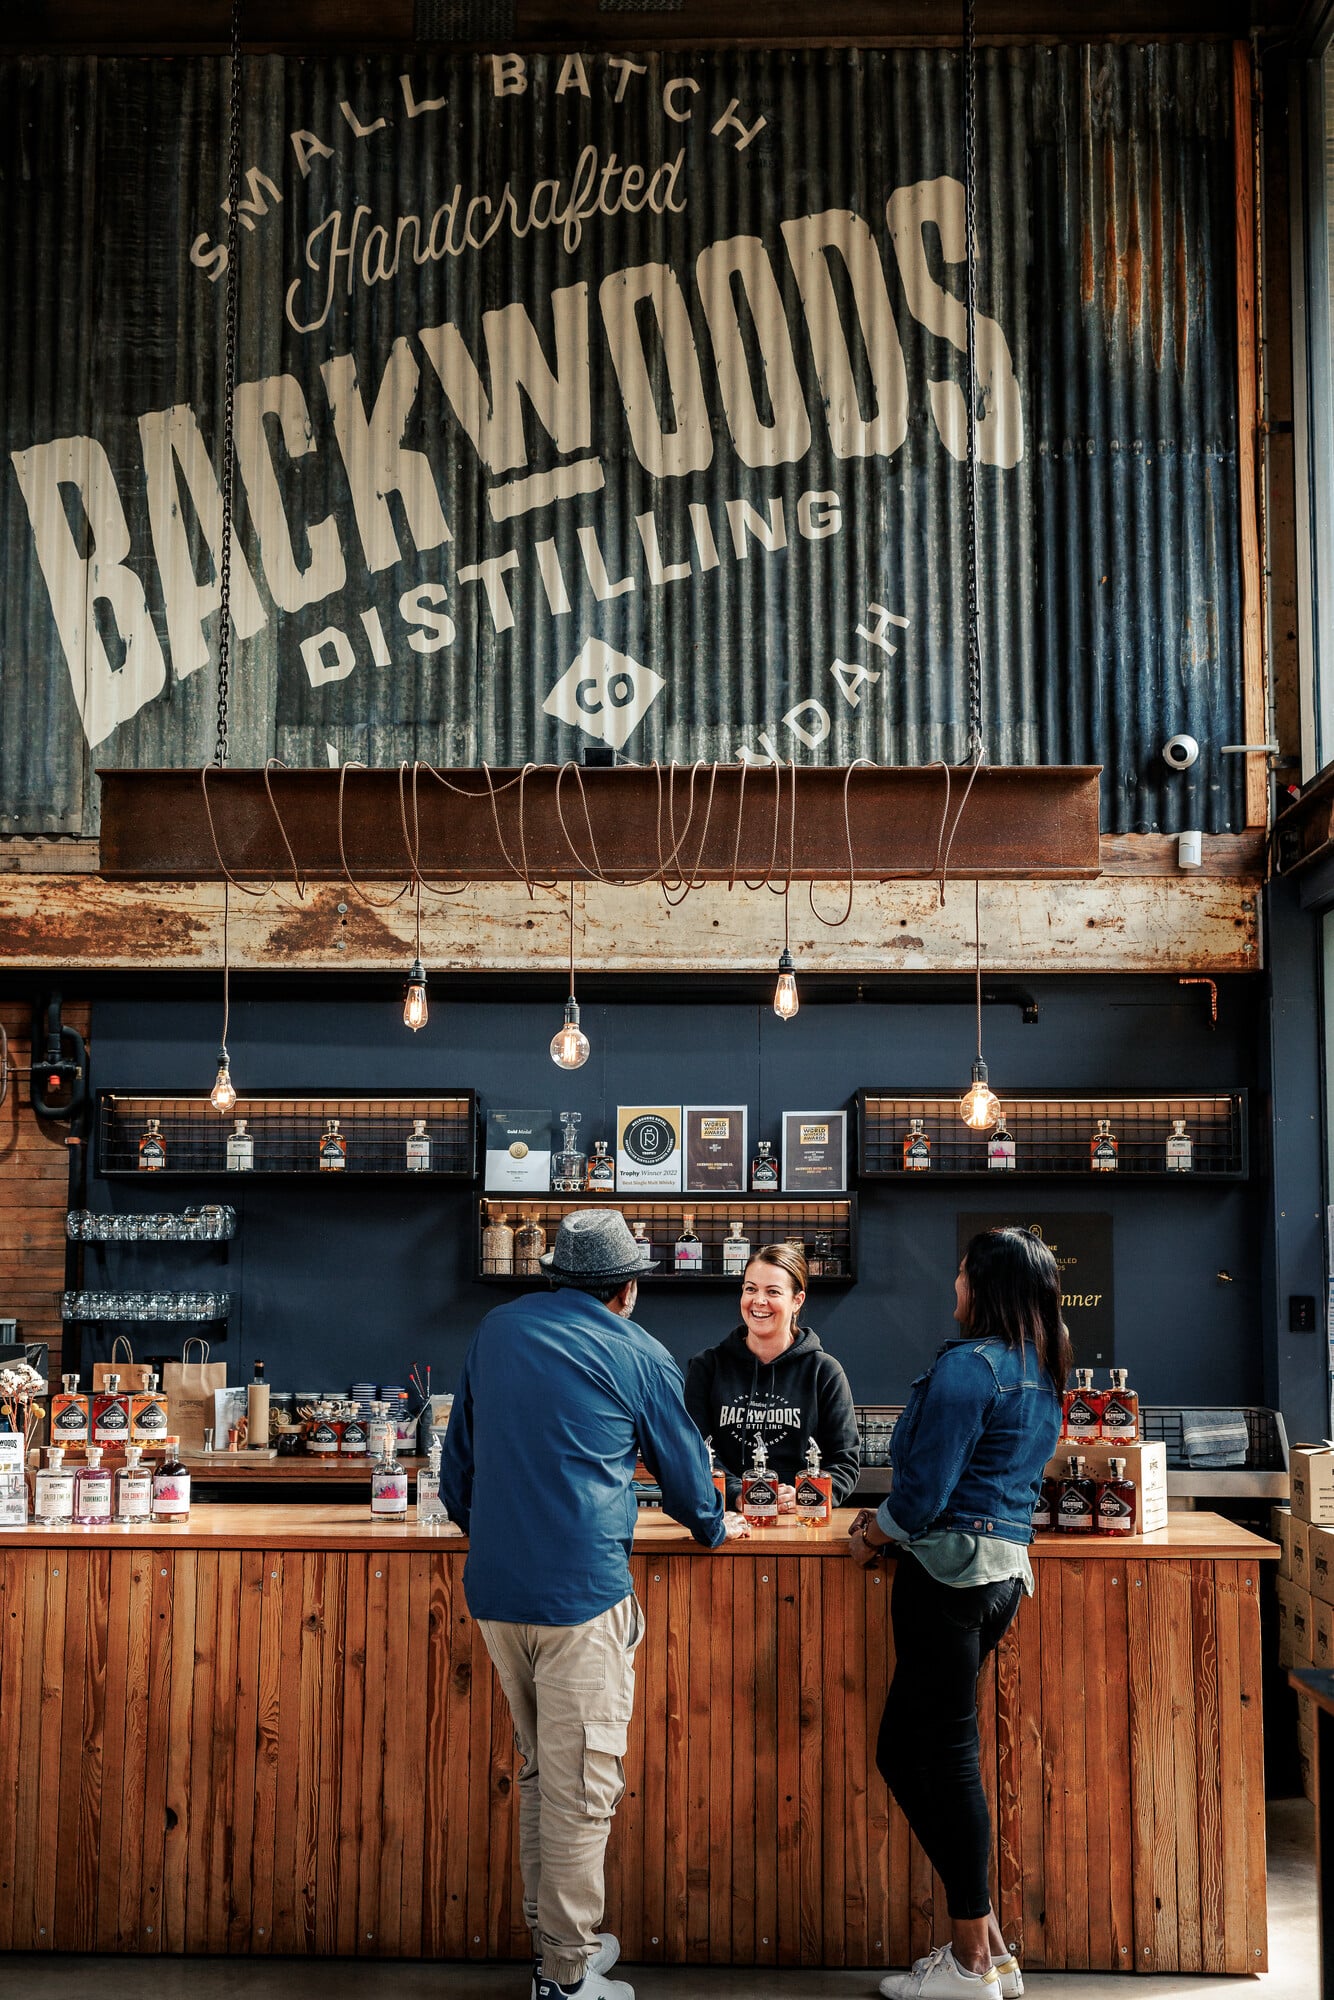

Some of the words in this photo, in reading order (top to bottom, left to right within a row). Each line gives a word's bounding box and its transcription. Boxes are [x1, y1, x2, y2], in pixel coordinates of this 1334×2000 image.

[190, 74, 447, 283] SMALL
[491, 52, 768, 151] BATCH
[285, 145, 688, 333] Handcrafted
[10, 174, 1025, 749] BACKWOODS
[300, 489, 843, 689] DISTILLING
[575, 671, 636, 715] CO
[719, 1405, 801, 1430] BACKWOODS
[730, 1431, 789, 1448] YACKANANDAH
